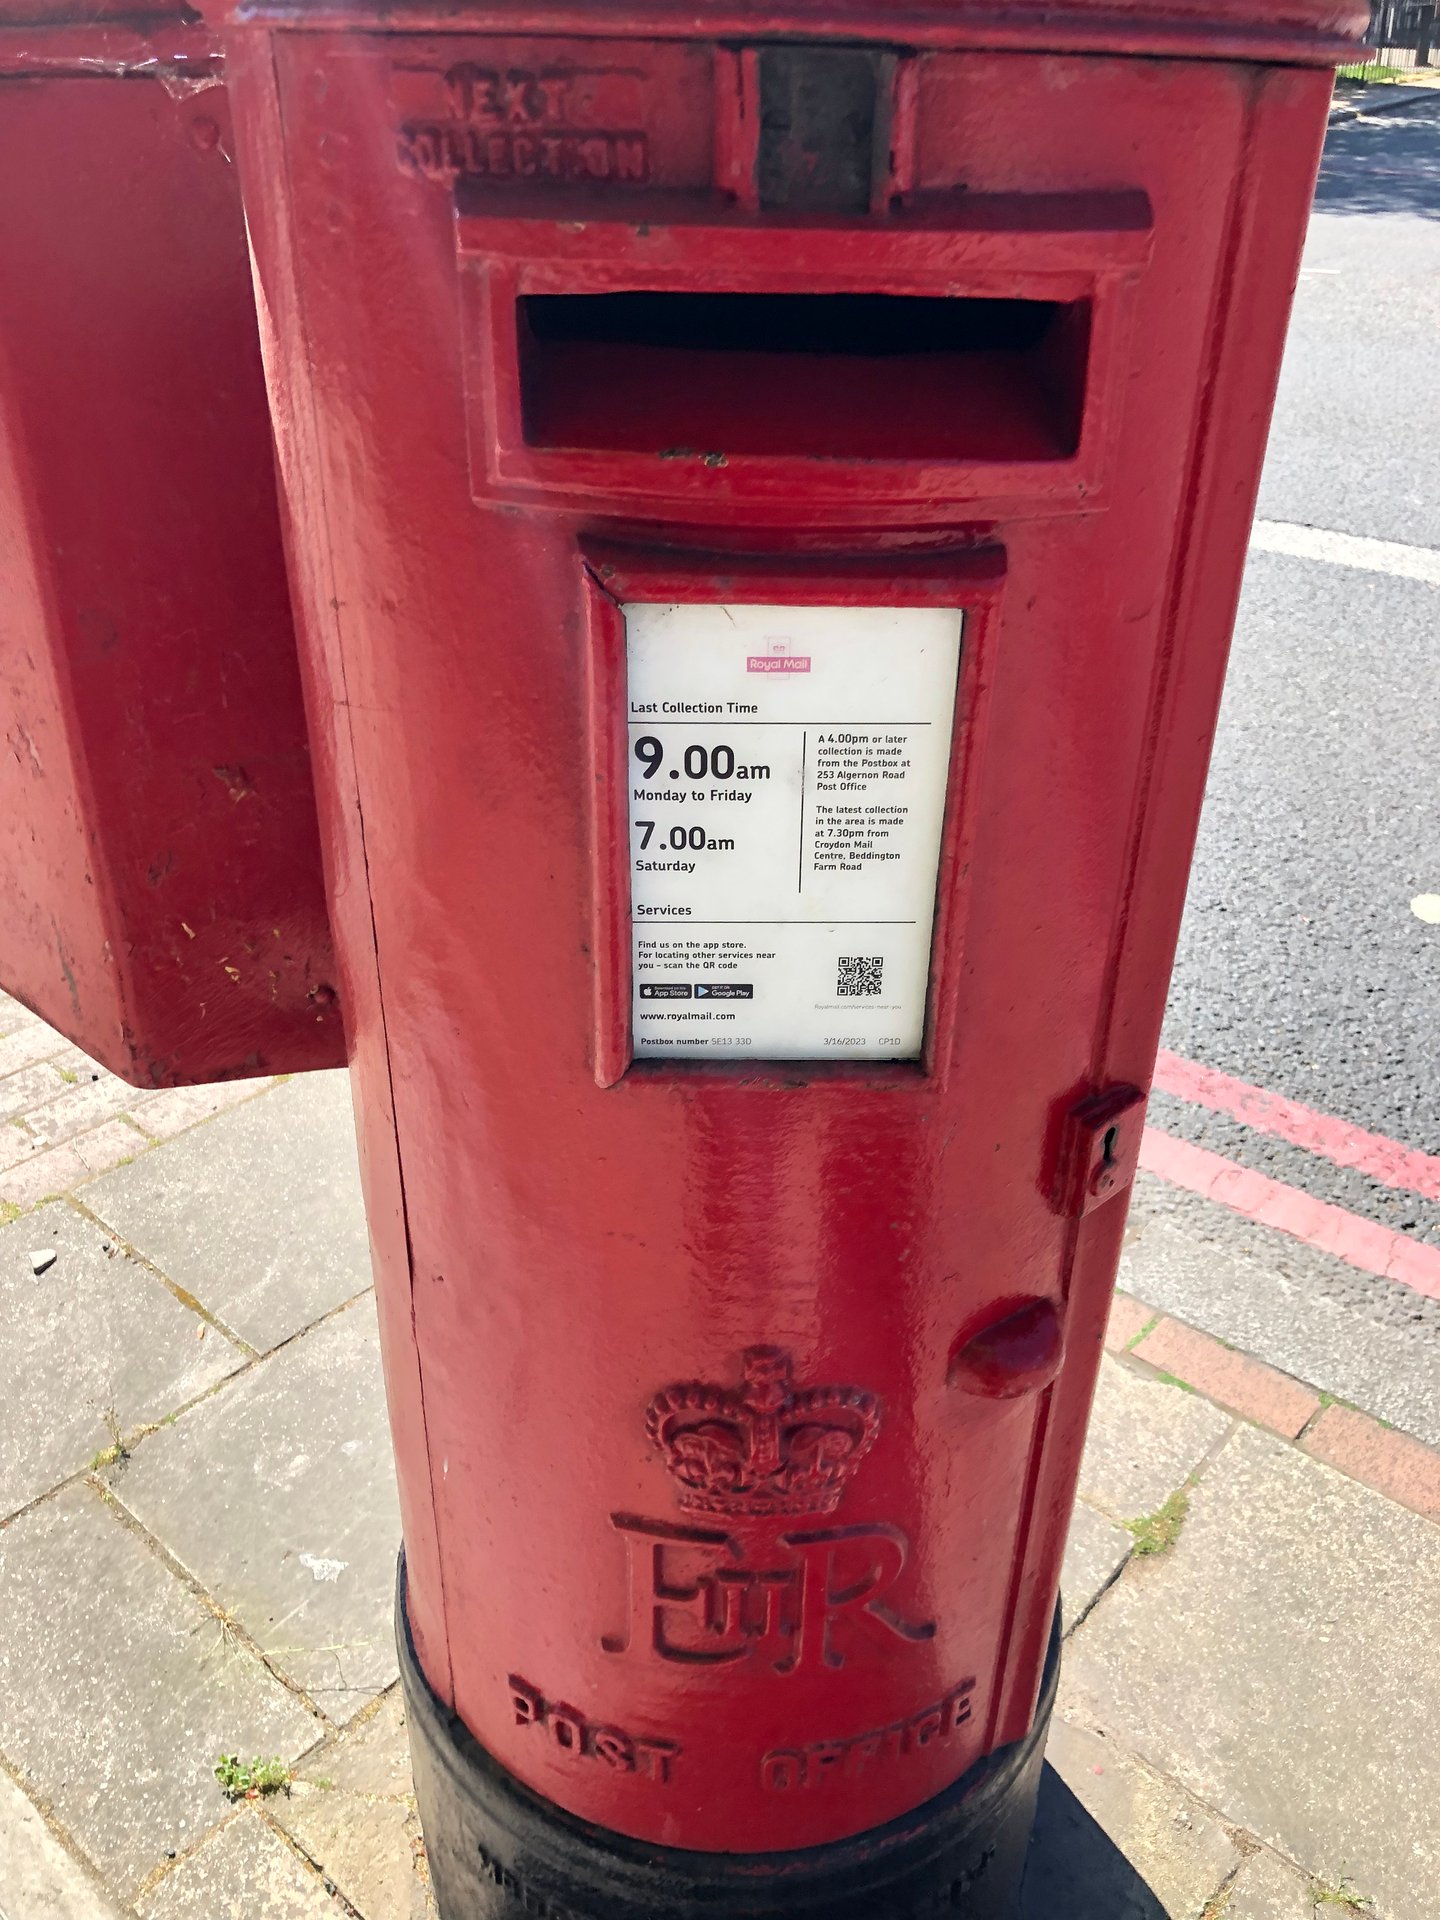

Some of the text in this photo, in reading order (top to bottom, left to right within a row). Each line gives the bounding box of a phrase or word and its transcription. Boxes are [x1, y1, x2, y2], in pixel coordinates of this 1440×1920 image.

[447, 78, 567, 123] NEXT
[750, 659, 807, 671] Royal Mail
[630, 701, 758, 714] Last Collection Time
[818, 733, 908, 746] A 4.00pm or later
[817, 746, 903, 756] collection is made
[633, 735, 771, 780] 9.00am
[817, 758, 911, 768] from the Postbox at
[817, 770, 906, 781] 253 Algernon Road
[816, 782, 867, 791] Post Office
[633, 788, 753, 804] Monday to Friday
[815, 805, 909, 814] The latest collection
[815, 816, 904, 826] in the area is made
[634, 820, 735, 851] 7.00am
[814, 828, 889, 839] at 7.30pm from
[814, 840, 873, 850] Croydon Mail
[814, 851, 901, 862] Centre, Beddington
[635, 859, 696, 874] Saturday
[813, 862, 862, 871] Farm Road
[636, 904, 692, 916] Services
[638, 940, 657, 949] Find
[685, 941, 701, 949] the
[702, 942, 720, 950] app
[721, 941, 747, 949] store.
[638, 951, 653, 959] For
[655, 951, 690, 961] locating
[692, 951, 716, 959] other
[718, 951, 754, 959] services
[638, 963, 654, 971] you
[685, 961, 701, 969] the
[702, 961, 716, 969] QR
[717, 961, 738, 969] code
[639, 1011, 736, 1022] www.royalmail.com
[640, 1037, 674, 1046] Postbox
[711, 1037, 733, 1047] SE13
[735, 1037, 752, 1047] 33D
[823, 1037, 866, 1046] 3/16/2023
[508, 1673, 976, 1793] POST OFFICE
